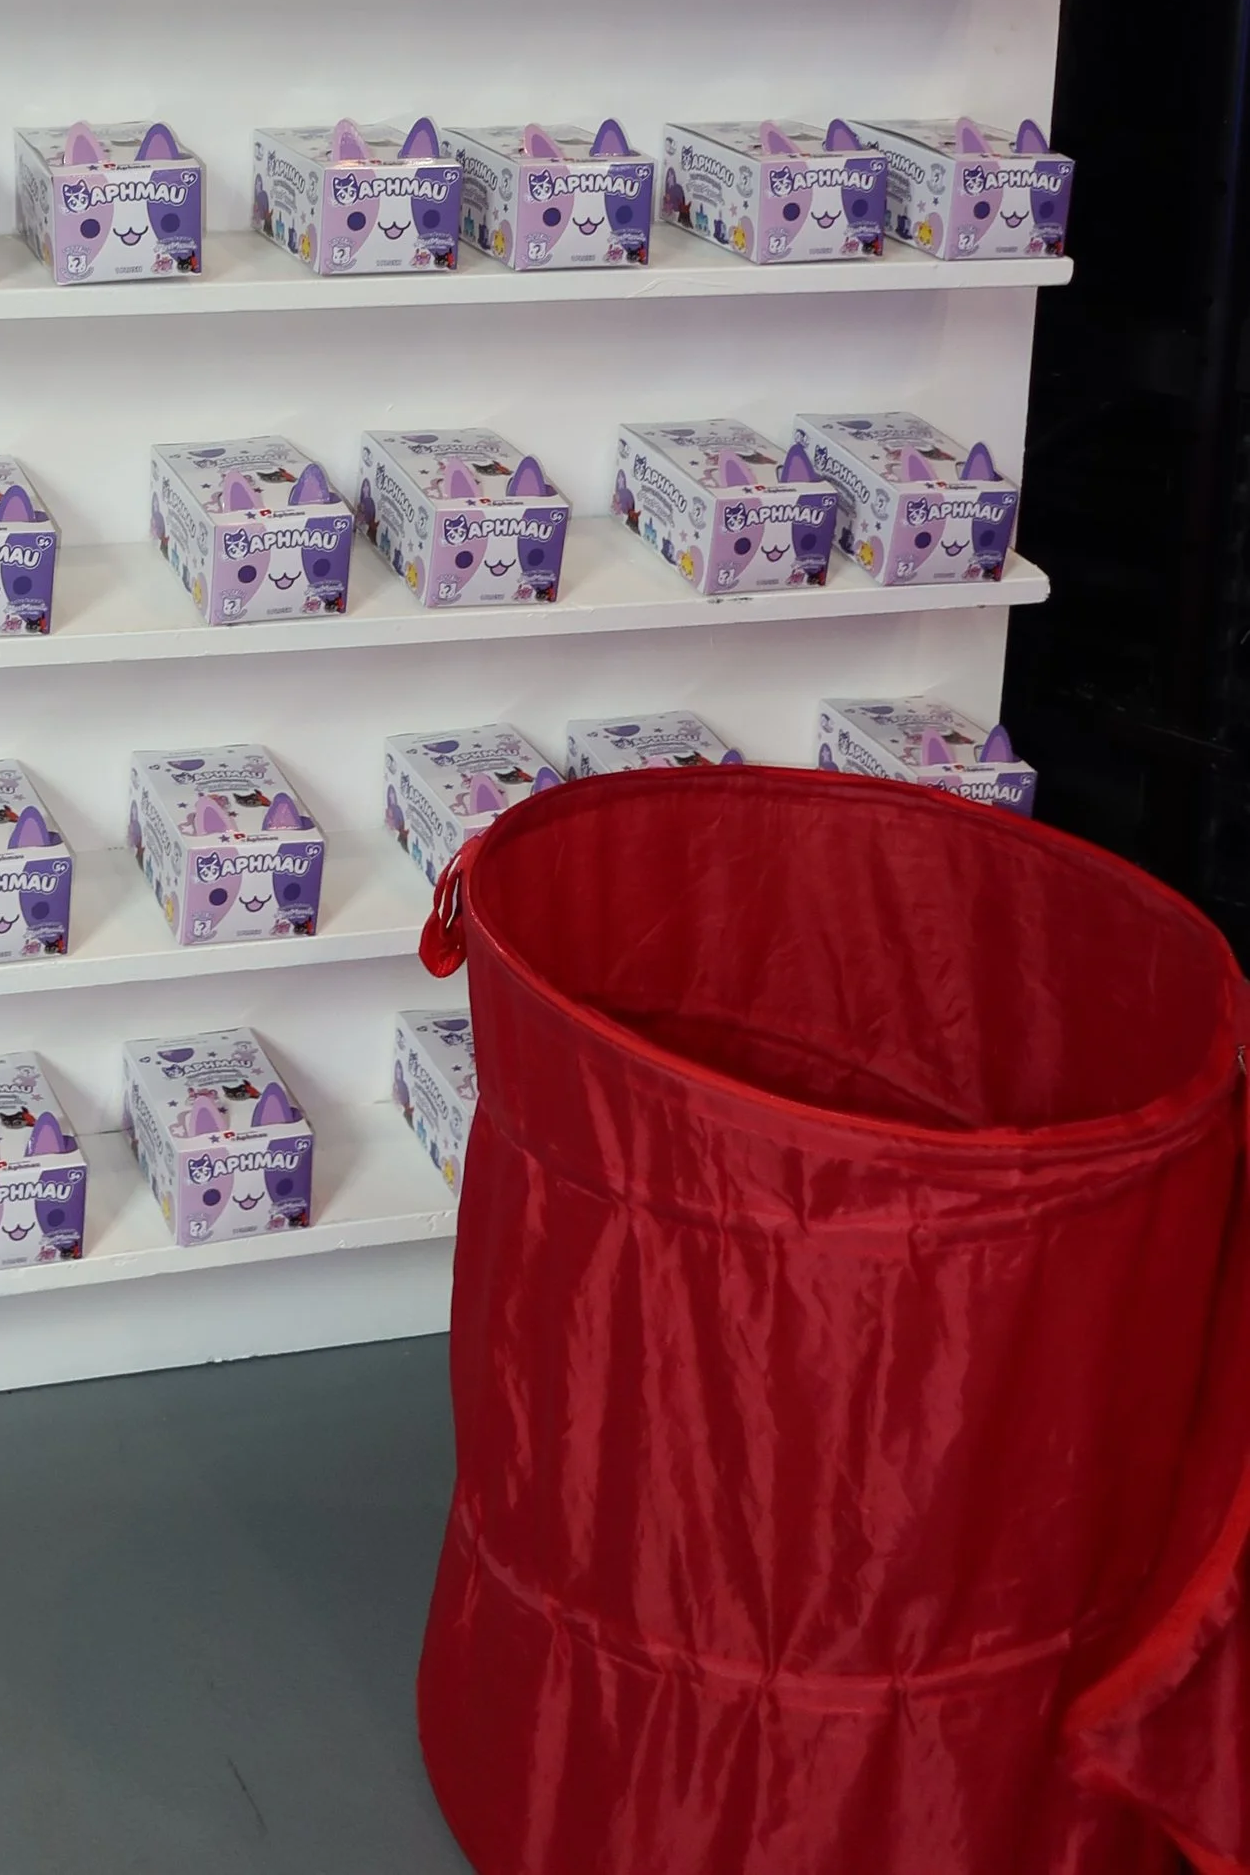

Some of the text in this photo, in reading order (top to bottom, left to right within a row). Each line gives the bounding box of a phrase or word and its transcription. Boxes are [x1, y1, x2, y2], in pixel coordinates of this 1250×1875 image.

[691, 153, 734, 189] APHMAU
[793, 168, 875, 191] APHMAU
[984, 170, 1062, 193] APHMAU
[90, 181, 187, 205] APHMAU
[358, 177, 448, 201] APHMAU
[552, 174, 640, 198] APHMAU
[642, 467, 688, 513] APHMAU
[824, 457, 869, 505] APHMAU
[748, 505, 824, 526] APHMAU
[929, 502, 1004, 522] APHMAU
[250, 530, 339, 554] APHMAU
[469, 519, 552, 542] APHMAU
[221, 853, 309, 877] APHMAU
[213, 1153, 299, 1177] APHMAU
